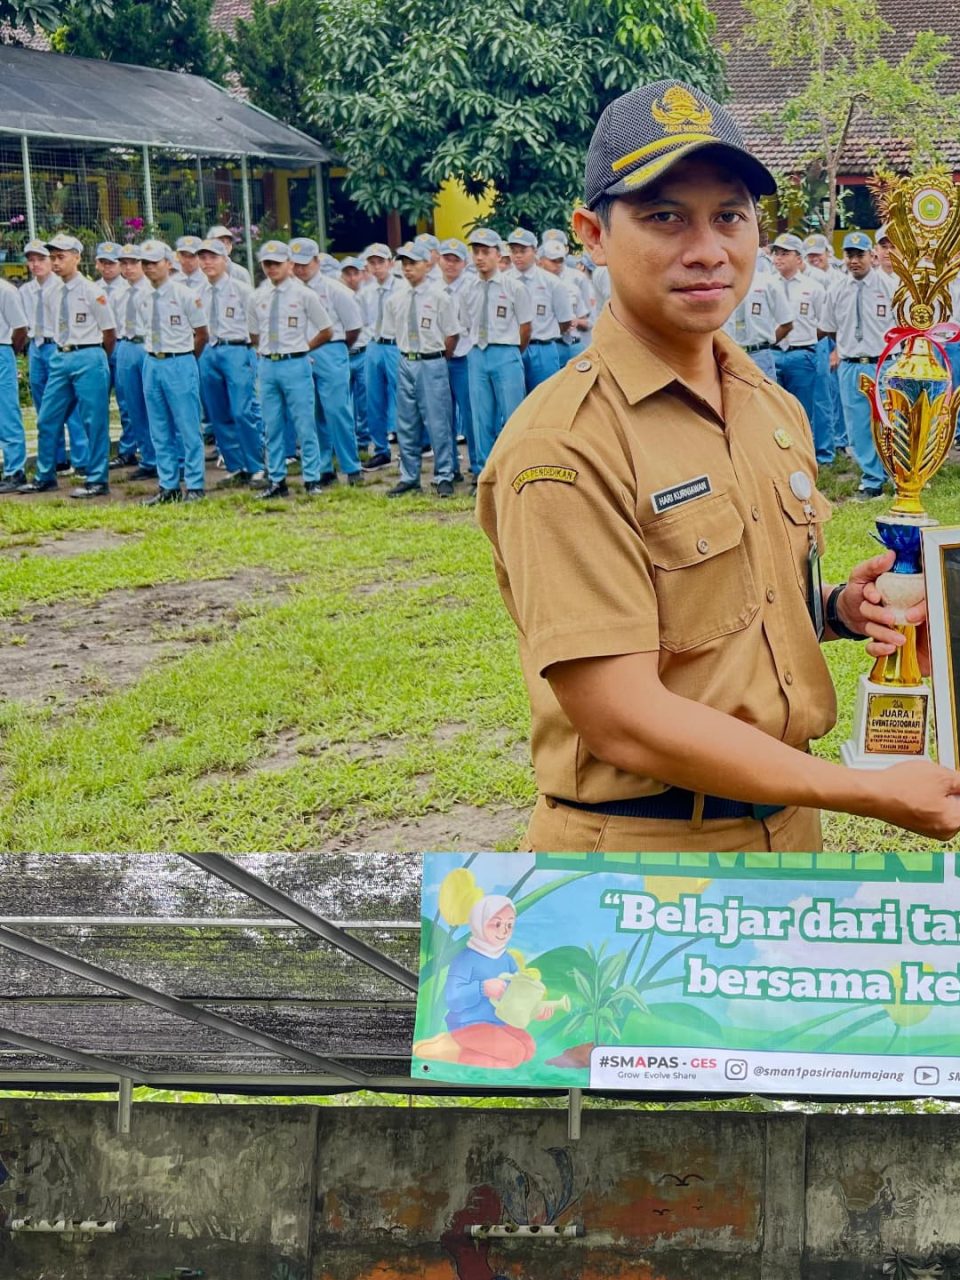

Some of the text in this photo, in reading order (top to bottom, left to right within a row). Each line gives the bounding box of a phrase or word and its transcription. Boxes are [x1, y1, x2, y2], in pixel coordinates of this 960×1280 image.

[658, 481, 707, 506] HARI KURNIAWAN
[880, 710, 909, 718] JUARA
[604, 892, 791, 944] “Belajar
[803, 901, 898, 940] dari
[687, 957, 893, 1001] bersama
[600, 1056, 718, 1069] #SMAPAS GES
[618, 1071, 697, 1081] Grow Evolve Share
[753, 1066, 904, 1083] @sman1pasirianlumajang
